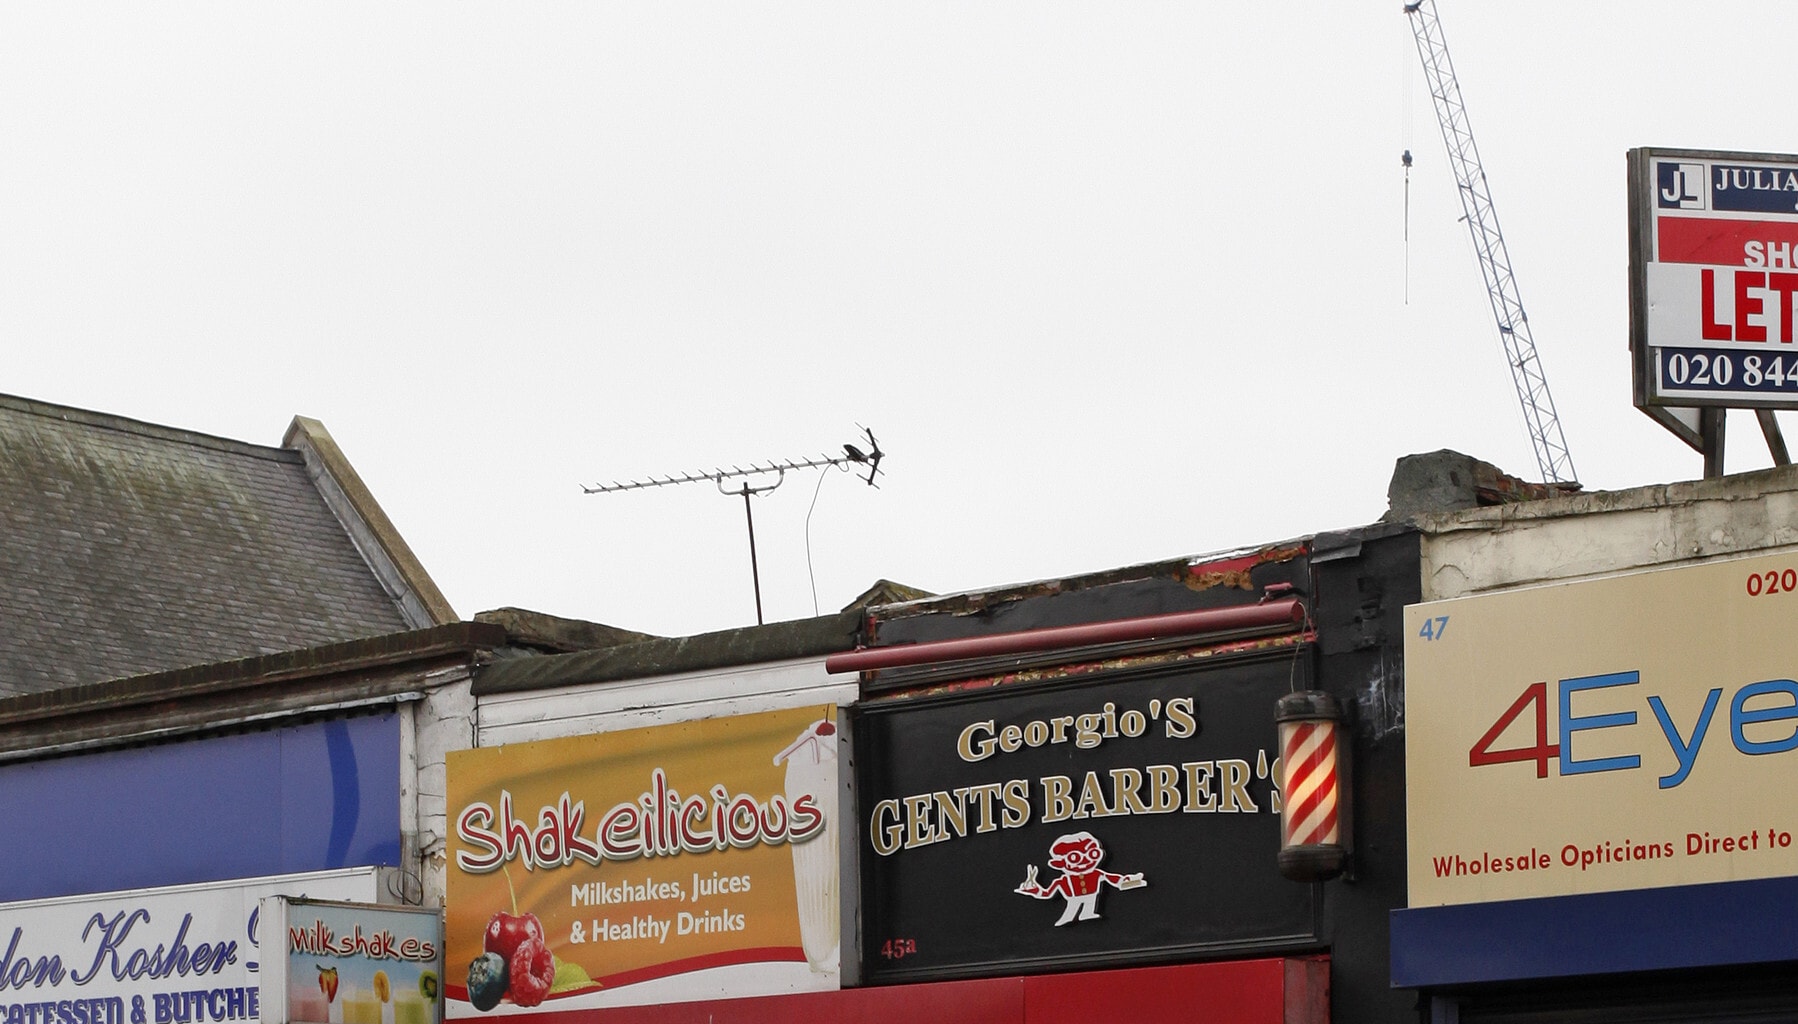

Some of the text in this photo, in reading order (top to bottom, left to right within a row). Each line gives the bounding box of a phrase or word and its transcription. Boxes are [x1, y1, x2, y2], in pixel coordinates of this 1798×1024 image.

[1716, 168, 1798, 191] JULIA
[1744, 240, 1798, 269] SH
[1701, 269, 1798, 343] LET
[1668, 353, 1733, 385] 020
[1746, 568, 1797, 597] 020
[1419, 616, 1449, 641] 47
[957, 697, 1197, 763] Georgio'S
[456, 767, 826, 873] Shakeilicious
[870, 779, 1030, 857] GENTS
[1433, 829, 1791, 877] Wholesale Opticians Direct to
[571, 873, 750, 906] Milkshakes, Juices
[289, 920, 437, 963] Milkshakes
[570, 909, 745, 944] & Healthy Drinks
[71, 908, 237, 985] Kosher
[881, 937, 917, 960] 45a
